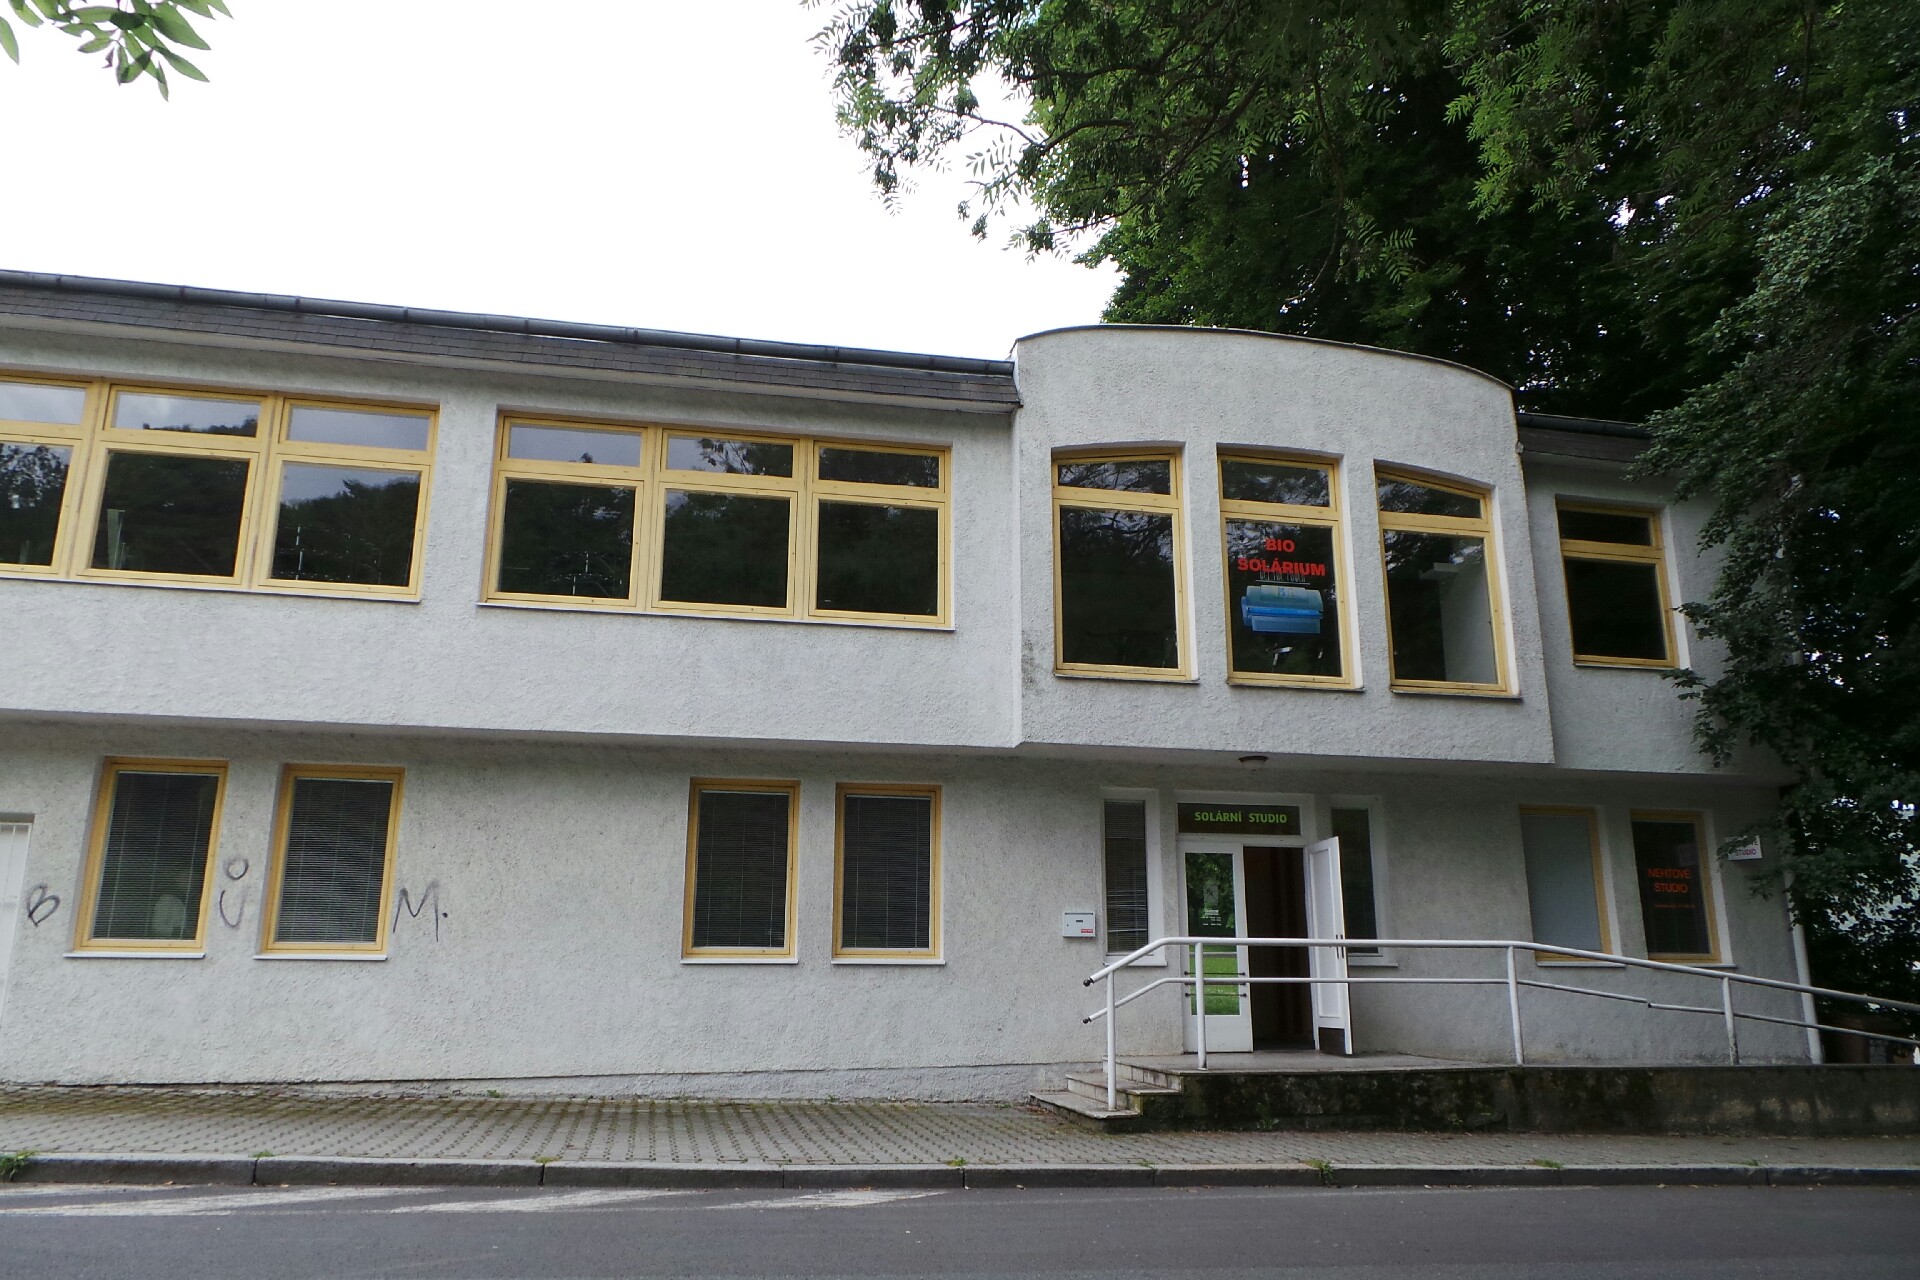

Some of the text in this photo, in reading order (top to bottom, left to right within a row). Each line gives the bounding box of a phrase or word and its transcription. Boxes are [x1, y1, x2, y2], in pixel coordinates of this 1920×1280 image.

[1265, 538, 1296, 553] BIO
[1237, 557, 1326, 577] SOLÁRIUM
[1194, 810, 1288, 824] SOLÁRNÍ STUDIO
[1654, 882, 1690, 894] STUDIO
